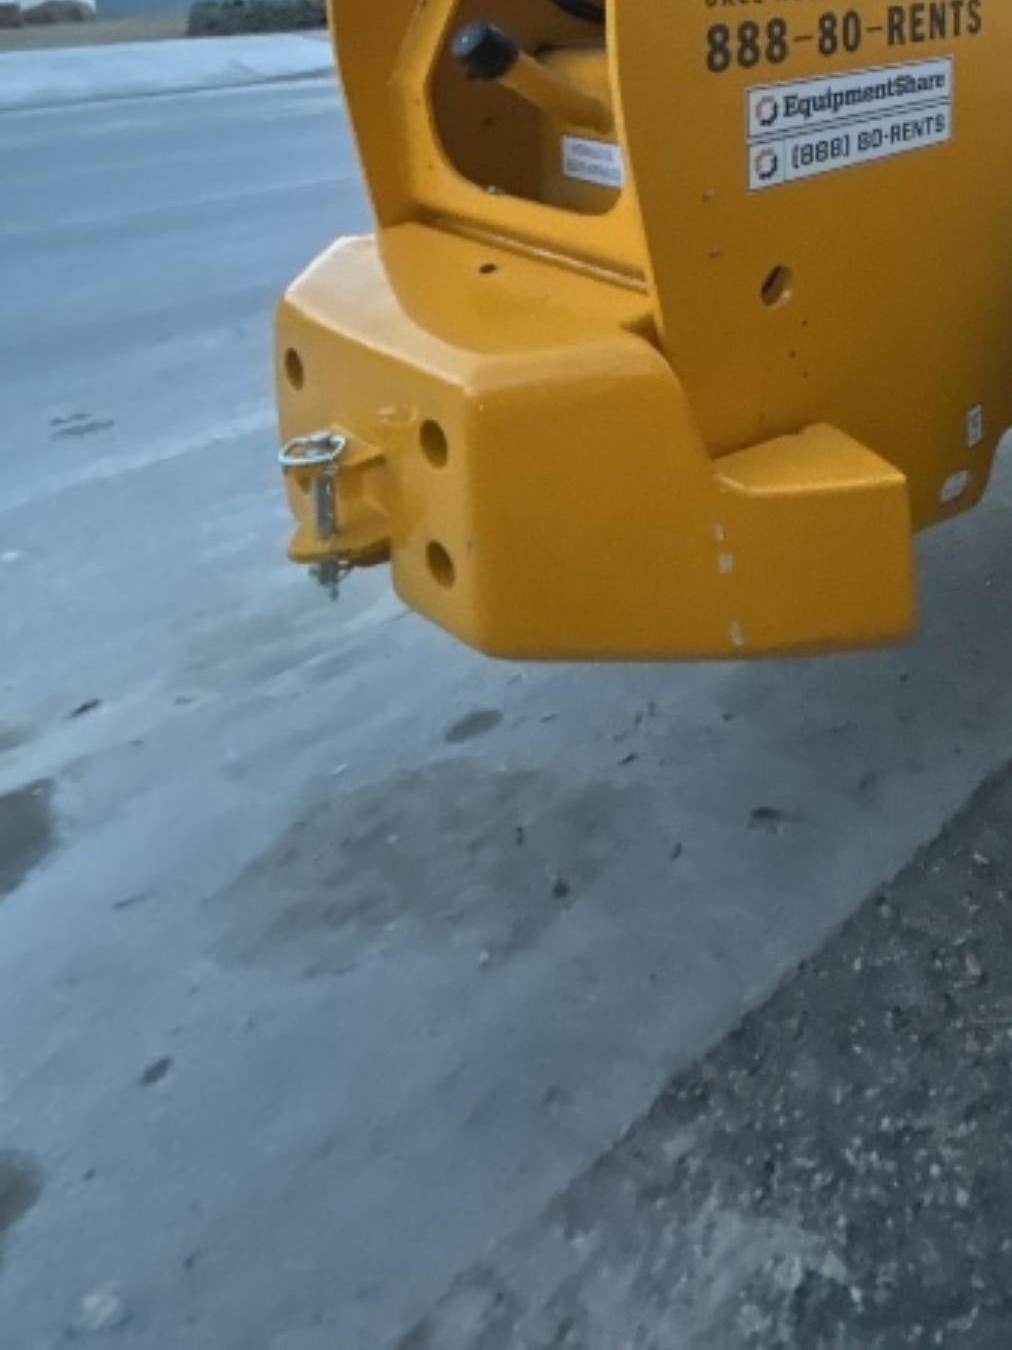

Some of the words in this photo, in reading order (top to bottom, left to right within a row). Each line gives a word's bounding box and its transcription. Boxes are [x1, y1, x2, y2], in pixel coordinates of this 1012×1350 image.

[782, 71, 946, 120] EquipmentShare
[791, 135, 850, 170] (888)
[856, 113, 946, 150] 80-RENTS
